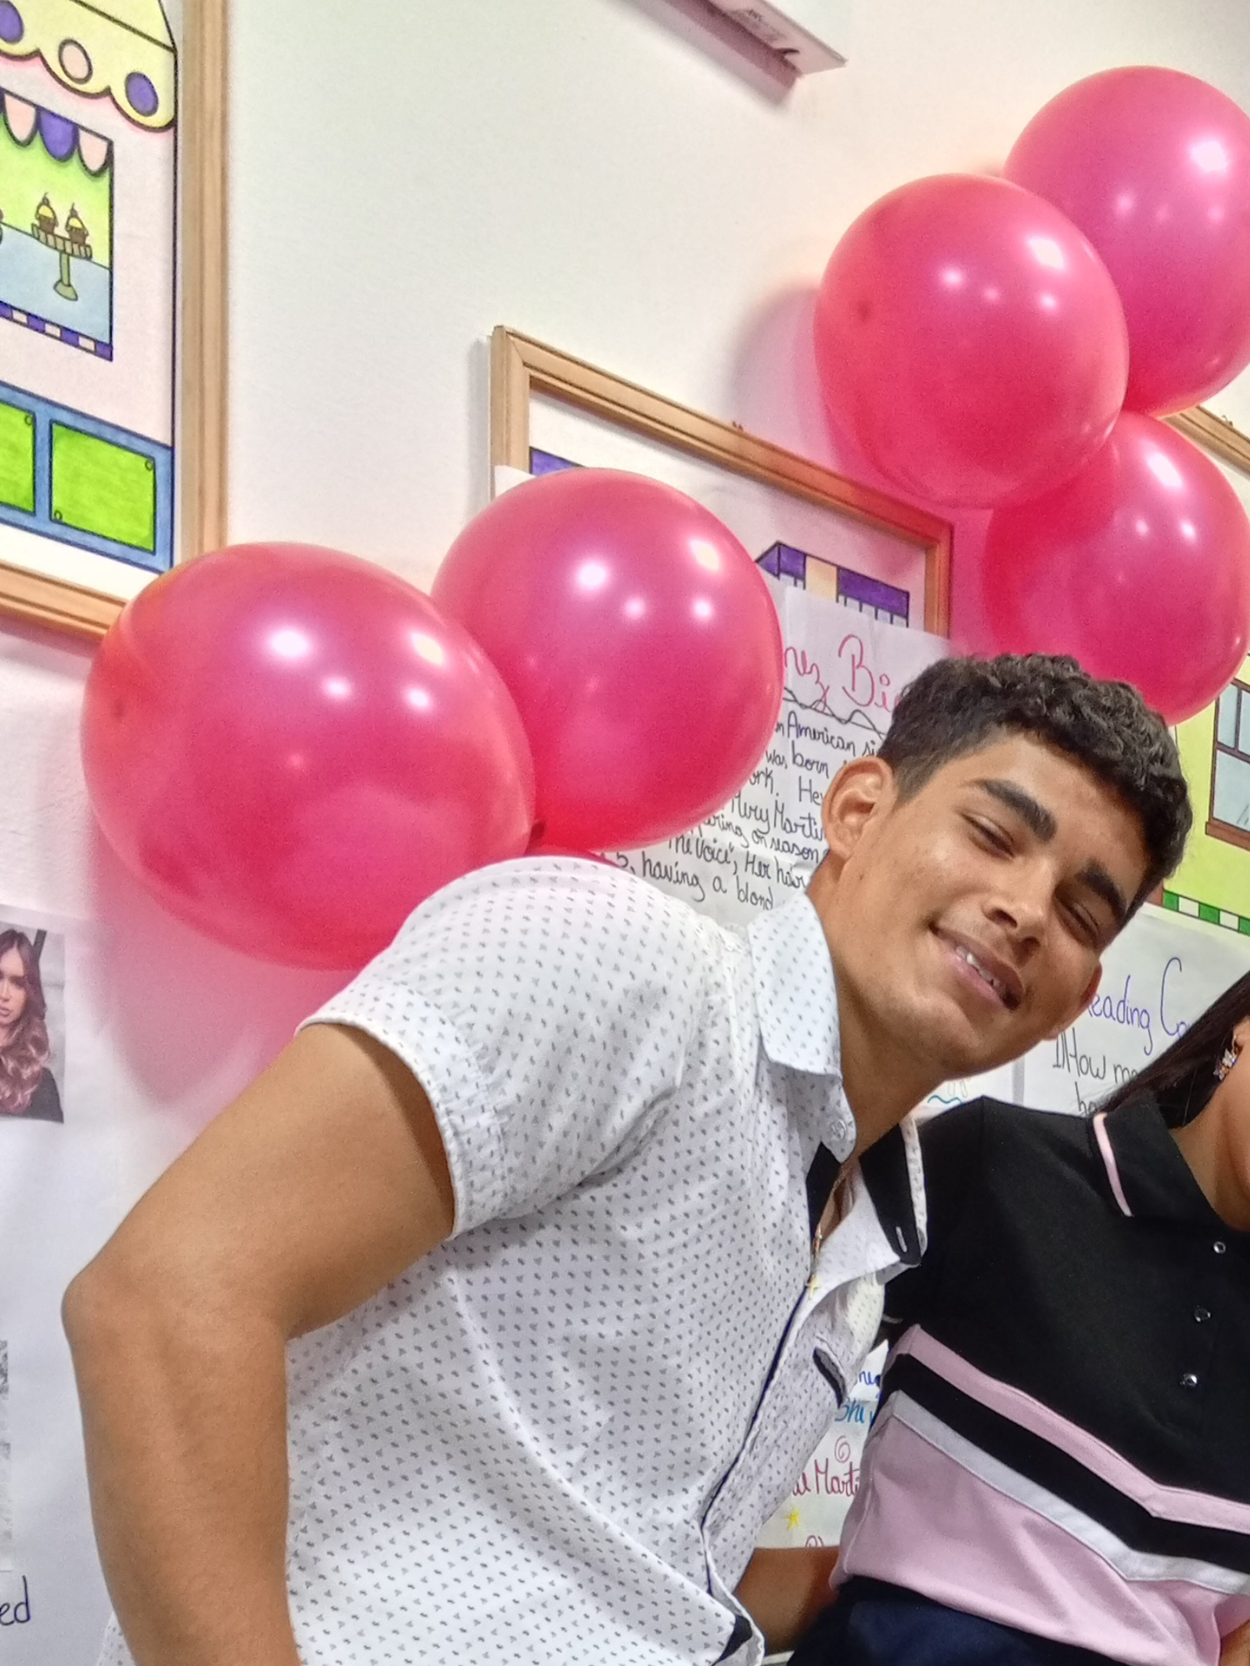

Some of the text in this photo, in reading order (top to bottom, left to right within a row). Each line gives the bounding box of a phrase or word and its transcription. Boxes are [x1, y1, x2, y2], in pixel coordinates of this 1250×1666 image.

[788, 710, 856, 757] American
[792, 740, 829, 780] born
[642, 851, 705, 902] having
[712, 875, 727, 894] a
[1088, 975, 1154, 1056] eading
